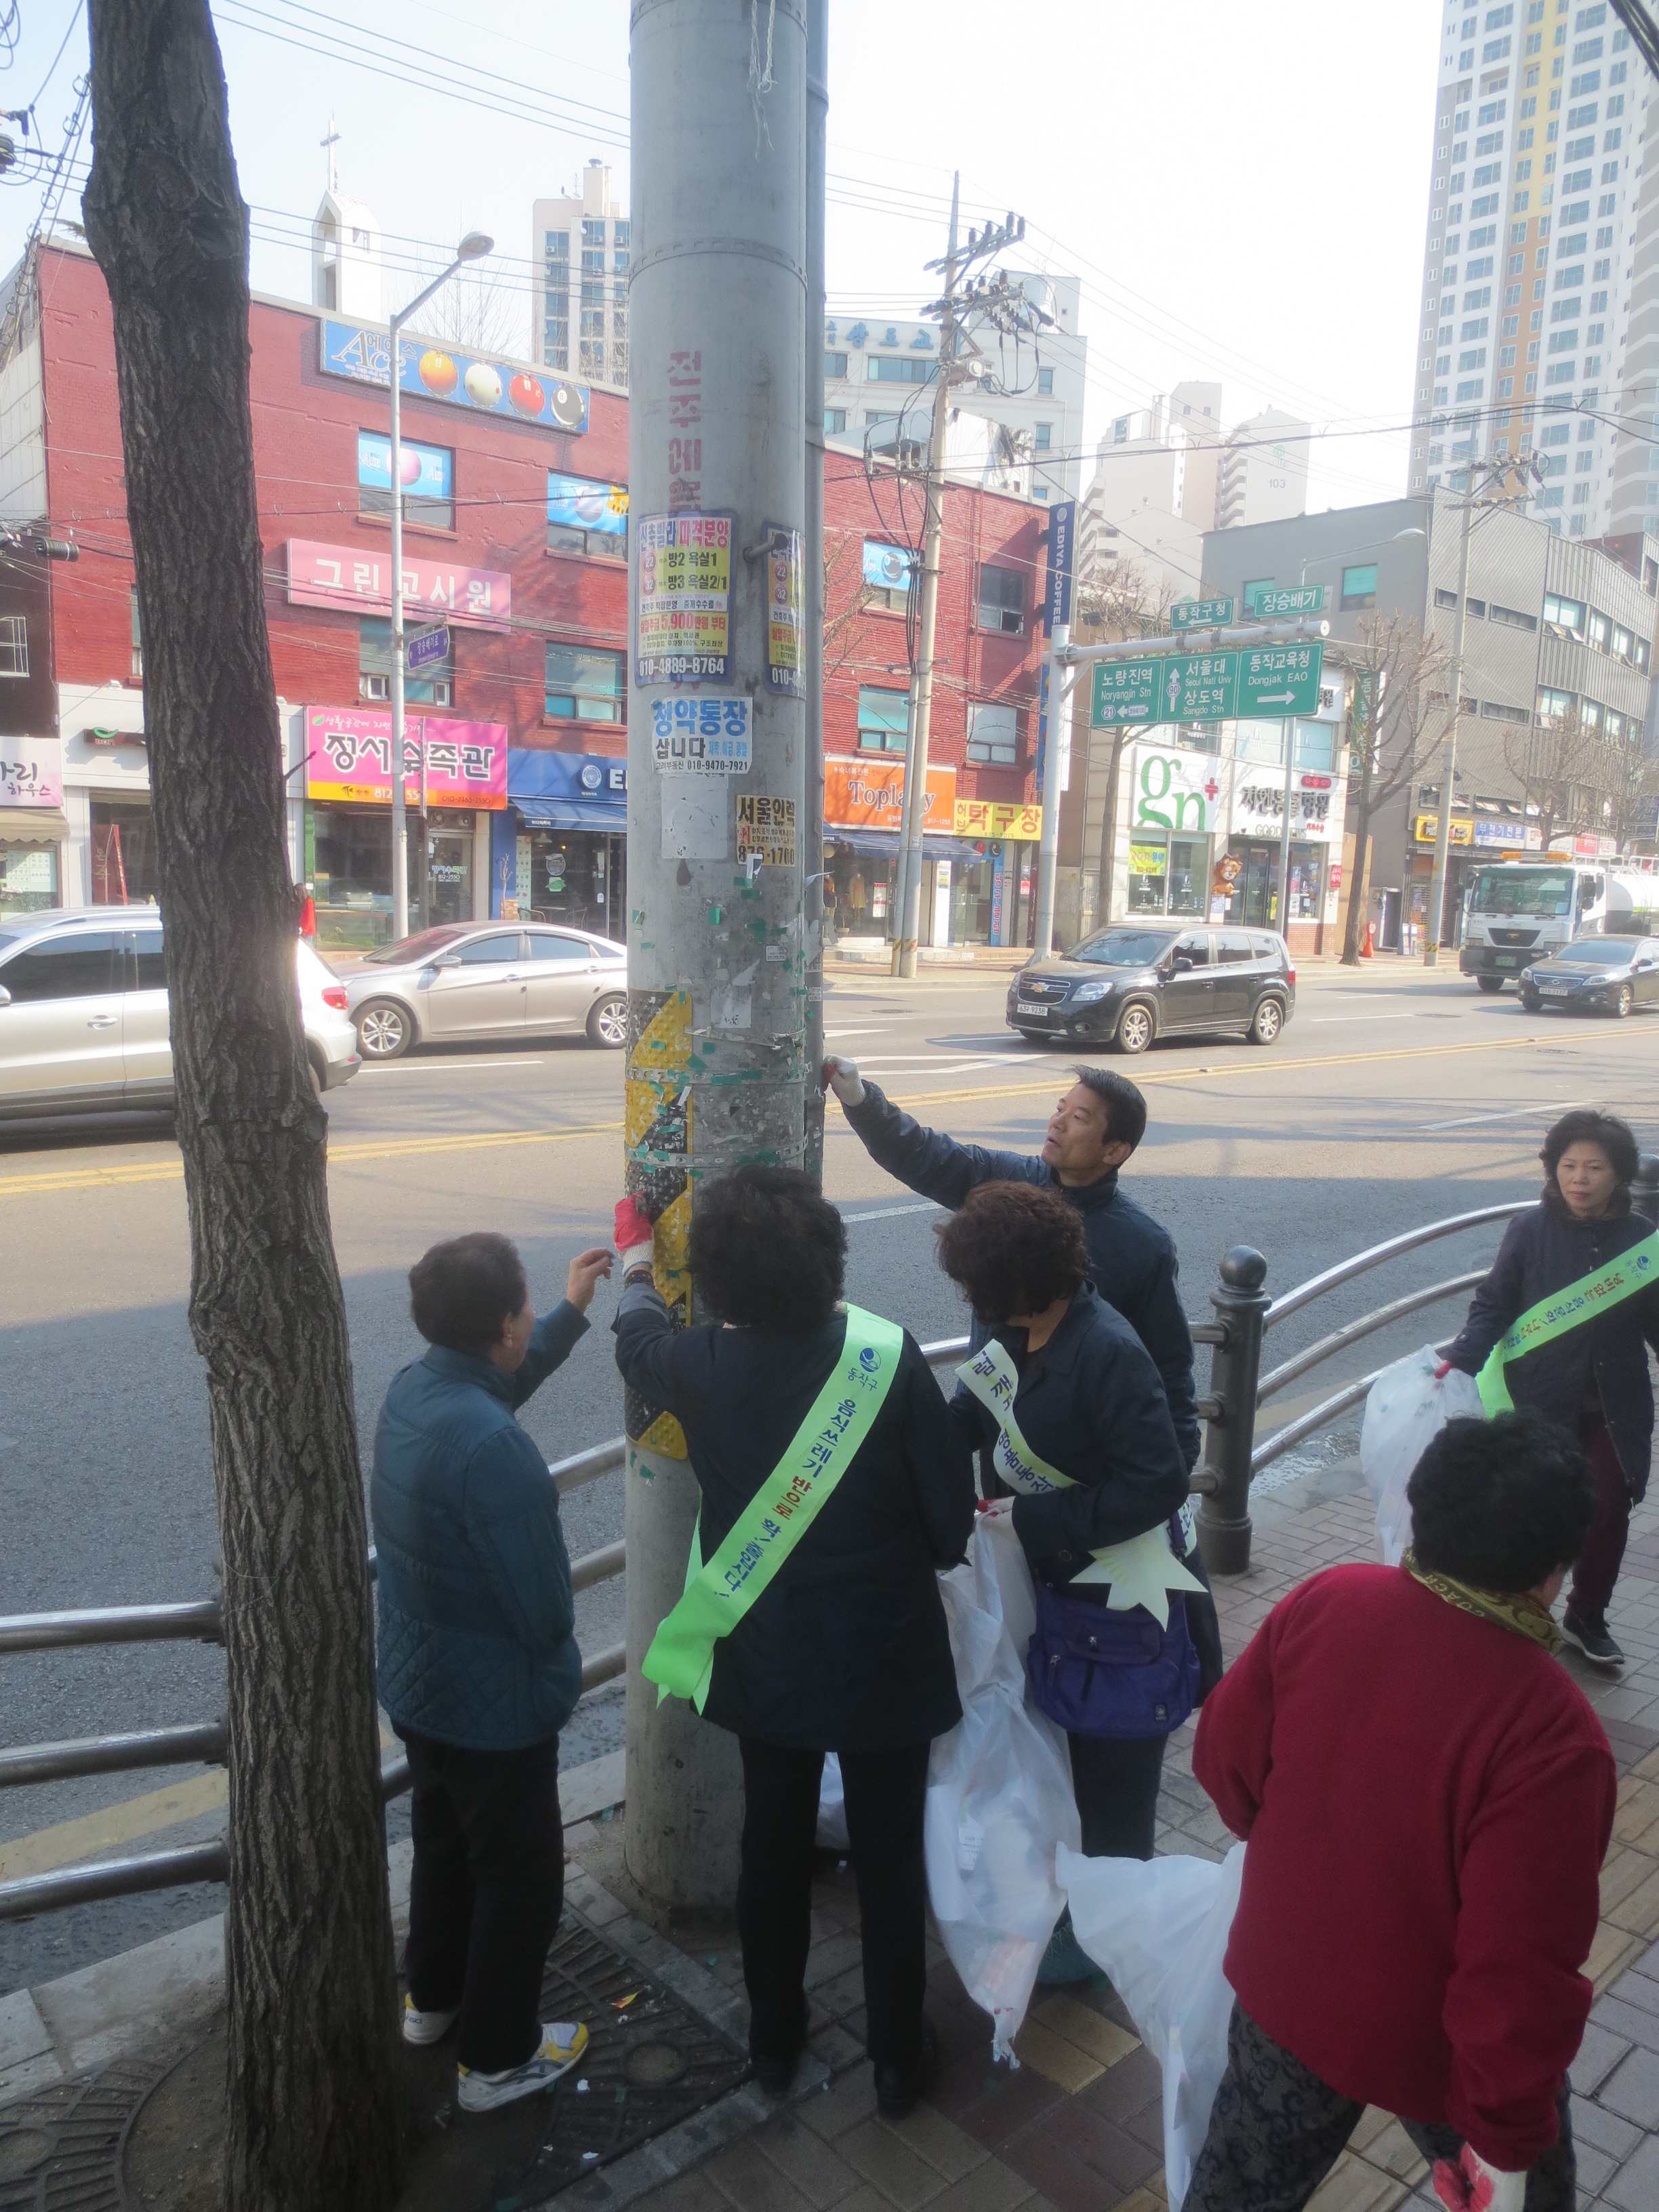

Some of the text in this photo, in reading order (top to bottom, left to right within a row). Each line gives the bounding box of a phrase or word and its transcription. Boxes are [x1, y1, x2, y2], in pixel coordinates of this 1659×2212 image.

[1269, 478, 1286, 489] 103
[679, 520, 729, 549] 파격분양
[645, 556, 654, 567] 22
[668, 552, 717, 568] 방2 욕실1
[777, 566, 786, 576] 22
[1052, 526, 1065, 624] EDIYA COFFEE
[314, 558, 491, 615] 그린고시원
[645, 579, 653, 590] 32
[668, 575, 684, 591] 방3
[777, 589, 786, 599] 32
[1263, 590, 1316, 611] 장승배기
[1178, 600, 1226, 621] 동작구청
[640, 657, 724, 676] 010-4889-8764
[1187, 657, 1226, 676] 서울대
[1250, 650, 1310, 672] 동작교육청
[1102, 667, 1153, 687] 노량진역
[1185, 678, 1202, 687] Seoul
[1218, 675, 1231, 684] Univ
[1248, 672, 1308, 687] Dongjak EAO
[1101, 688, 1151, 701] Noryangjin Stn
[1170, 684, 1179, 695] 90
[1184, 689, 1224, 705] 상도역
[653, 699, 747, 737] 청약통장
[1105, 708, 1113, 718] 21
[1183, 707, 1208, 716] Sangdo
[326, 715, 370, 731] 생활공간에
[655, 737, 705, 759] 삽니다
[656, 760, 747, 771] 고려부동산 010-9470-7921
[7, 782, 52, 797] 하우스
[1137, 755, 1206, 832] gn
[442, 796, 491, 804] 010-2463-2550
[968, 804, 1041, 834] 탁구장
[1480, 823, 1522, 838] 무전기전문
[993, 872, 1002, 935] 당구클럽
[1031, 1006, 1045, 1014] 9238
[972, 1350, 996, 1376] 럼
[846, 1367, 878, 1392] 동작구
[802, 1397, 857, 1479] 음식쓰레기
[772, 1475, 813, 1521] 반으로
